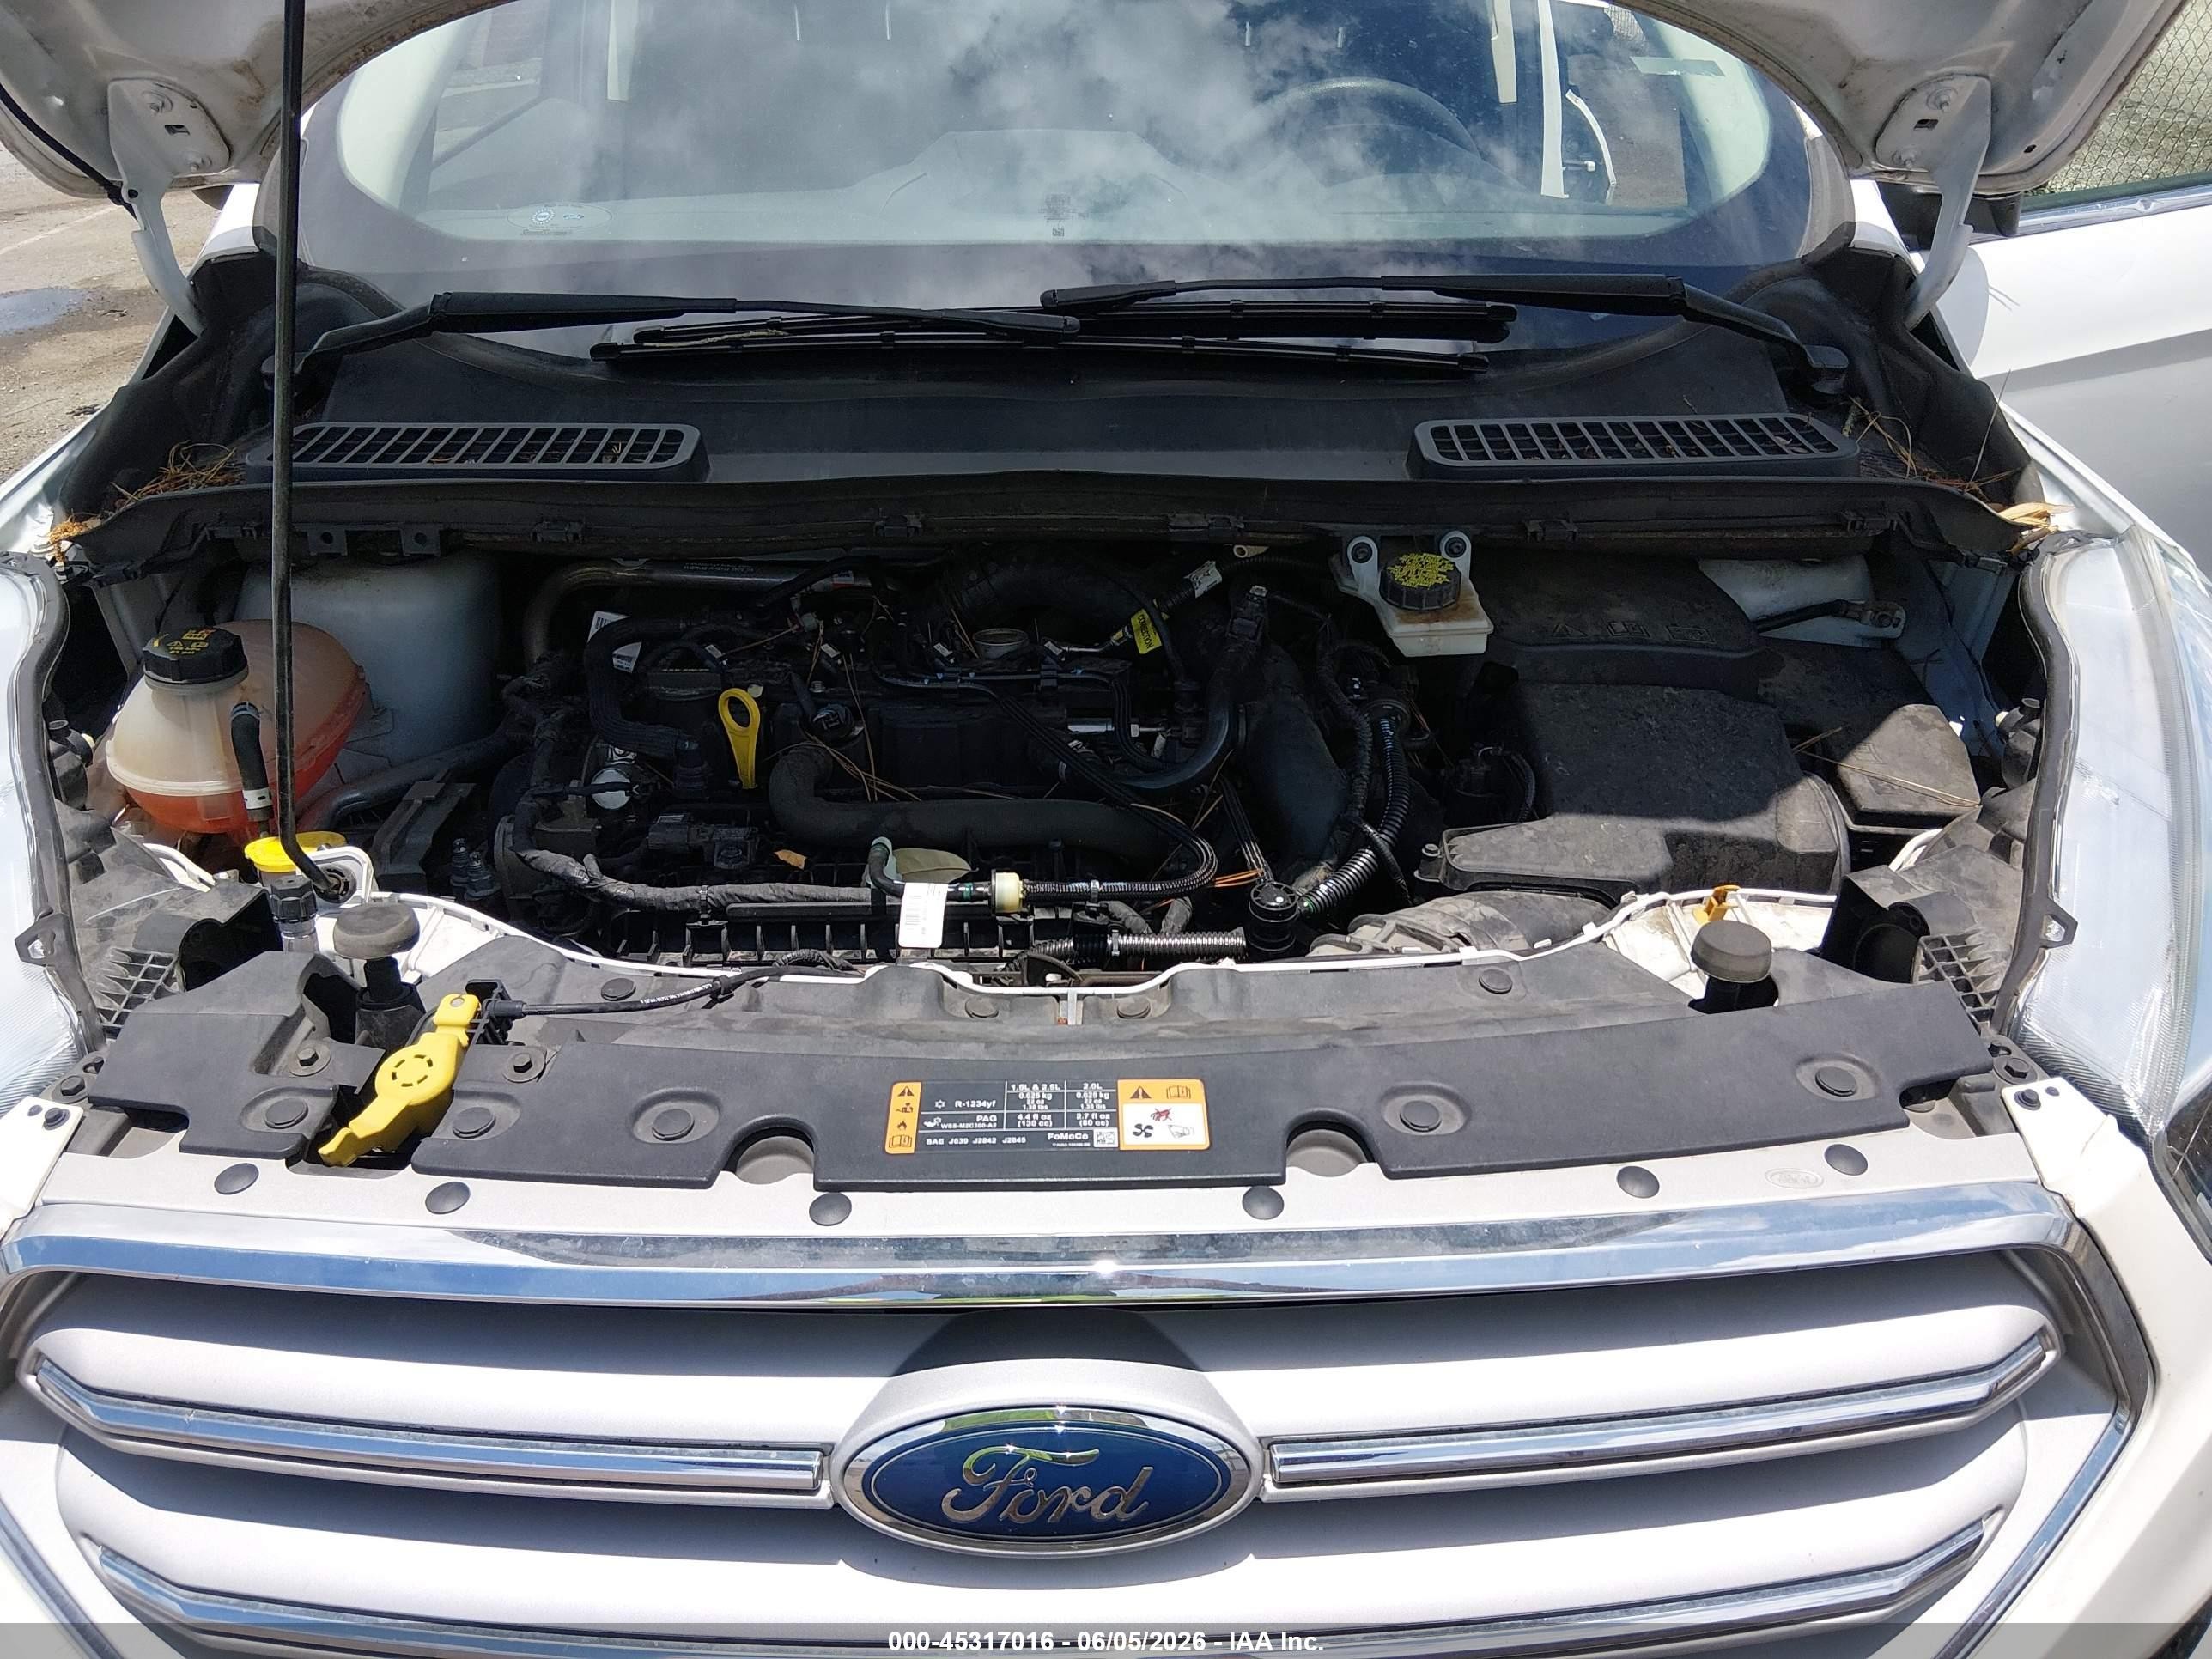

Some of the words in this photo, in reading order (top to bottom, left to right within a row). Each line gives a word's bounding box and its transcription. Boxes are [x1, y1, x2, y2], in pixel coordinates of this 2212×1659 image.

[1042, 1091, 1053, 1101] kg
[1099, 1091, 1110, 1100] kg
[955, 1100, 996, 1109] R-1234yf
[941, 1445, 1154, 1523] Ford
